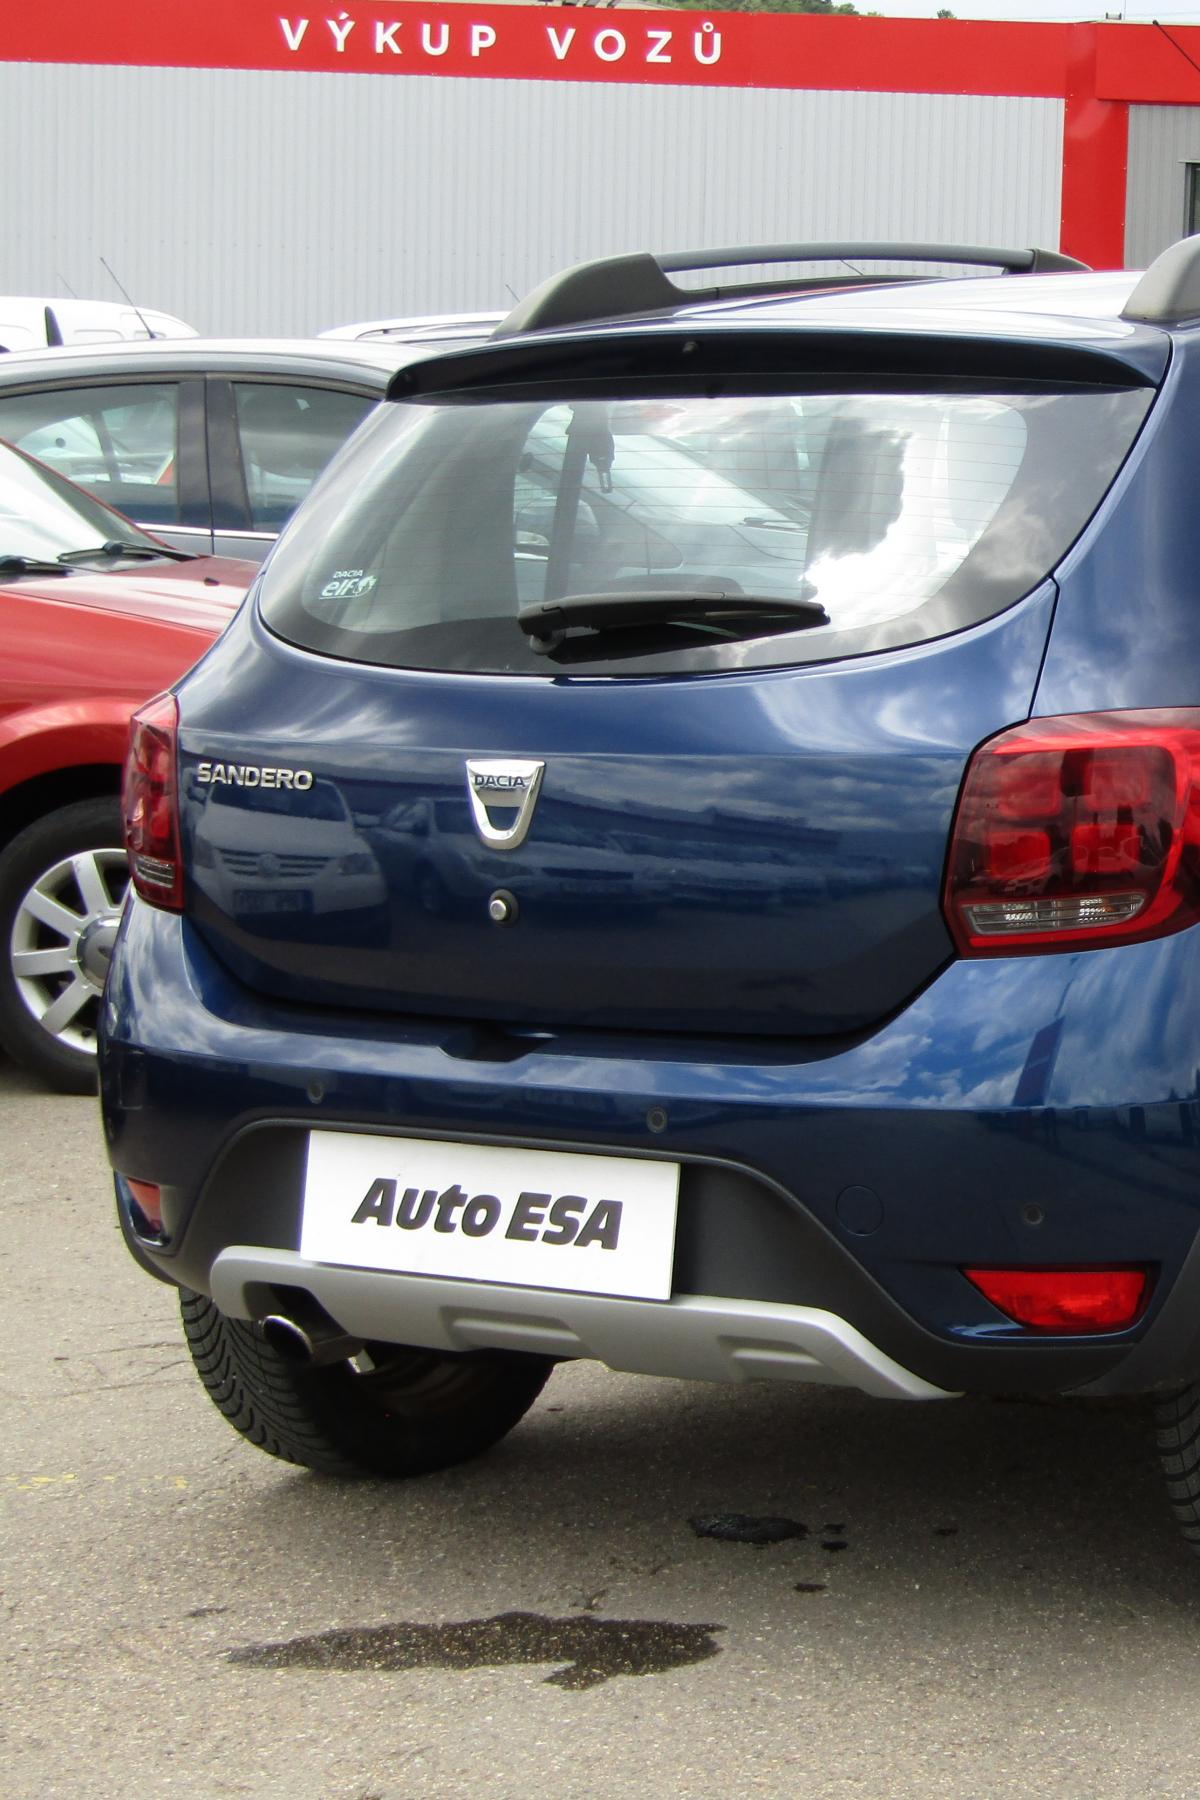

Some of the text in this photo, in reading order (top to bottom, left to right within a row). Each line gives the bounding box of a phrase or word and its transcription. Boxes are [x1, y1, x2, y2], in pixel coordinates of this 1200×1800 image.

[280, 13, 722, 65] VÝKUP VOZŮ
[321, 578, 360, 597] elf
[197, 762, 314, 791] SANDERO
[474, 775, 526, 788] DACIA
[351, 1178, 624, 1250] Auto ESA
